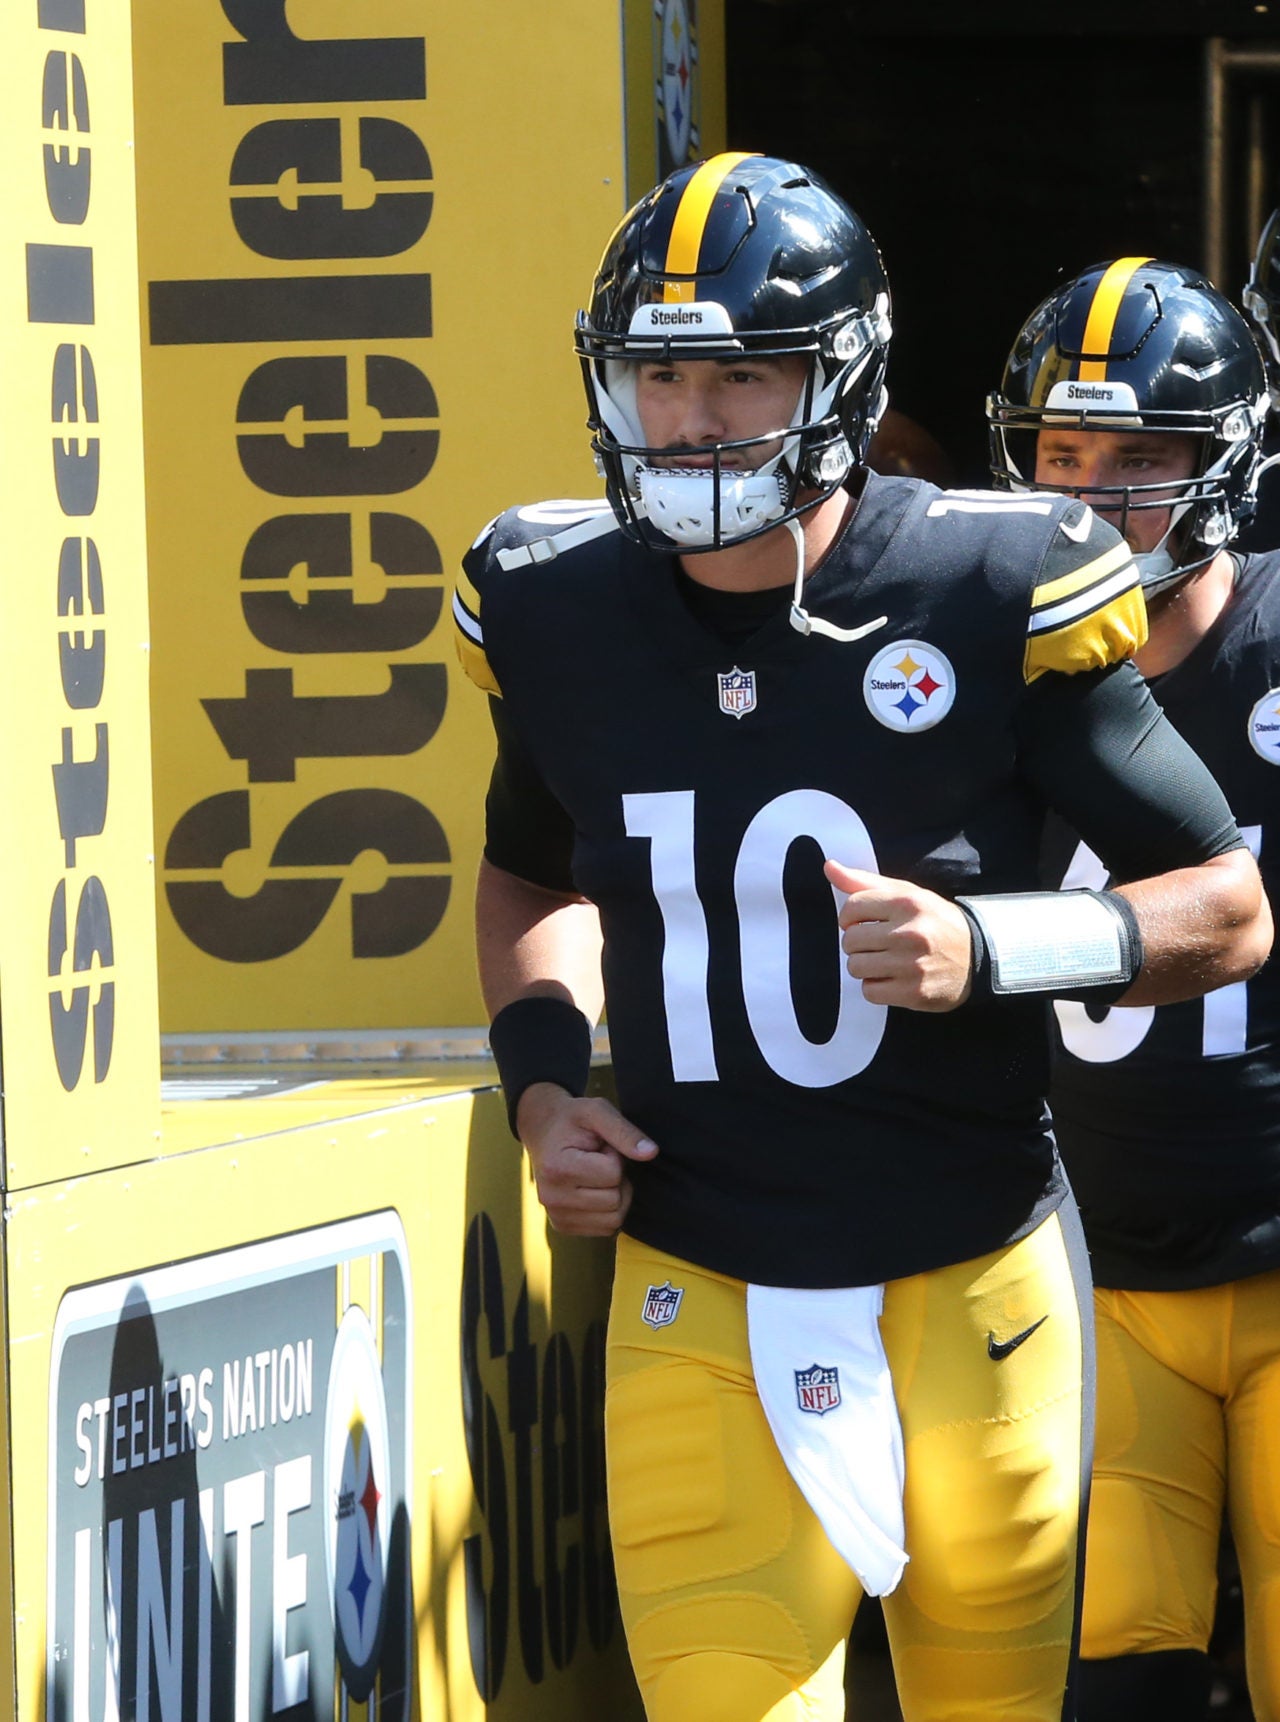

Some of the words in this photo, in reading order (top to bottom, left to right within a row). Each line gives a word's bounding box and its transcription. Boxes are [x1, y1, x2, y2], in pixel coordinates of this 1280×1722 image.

[650, 308, 703, 326] Steelers
[1067, 384, 1113, 402] Steelers
[870, 678, 907, 691] Steelers
[725, 689, 751, 708] NFL
[622, 788, 889, 1088] 10
[647, 1302, 670, 1320] NFL
[802, 1386, 841, 1410] NFL
[74, 1367, 214, 1487] STEELERS
[222, 1338, 313, 1441] NATION
[73, 1454, 312, 1722] UNITE
